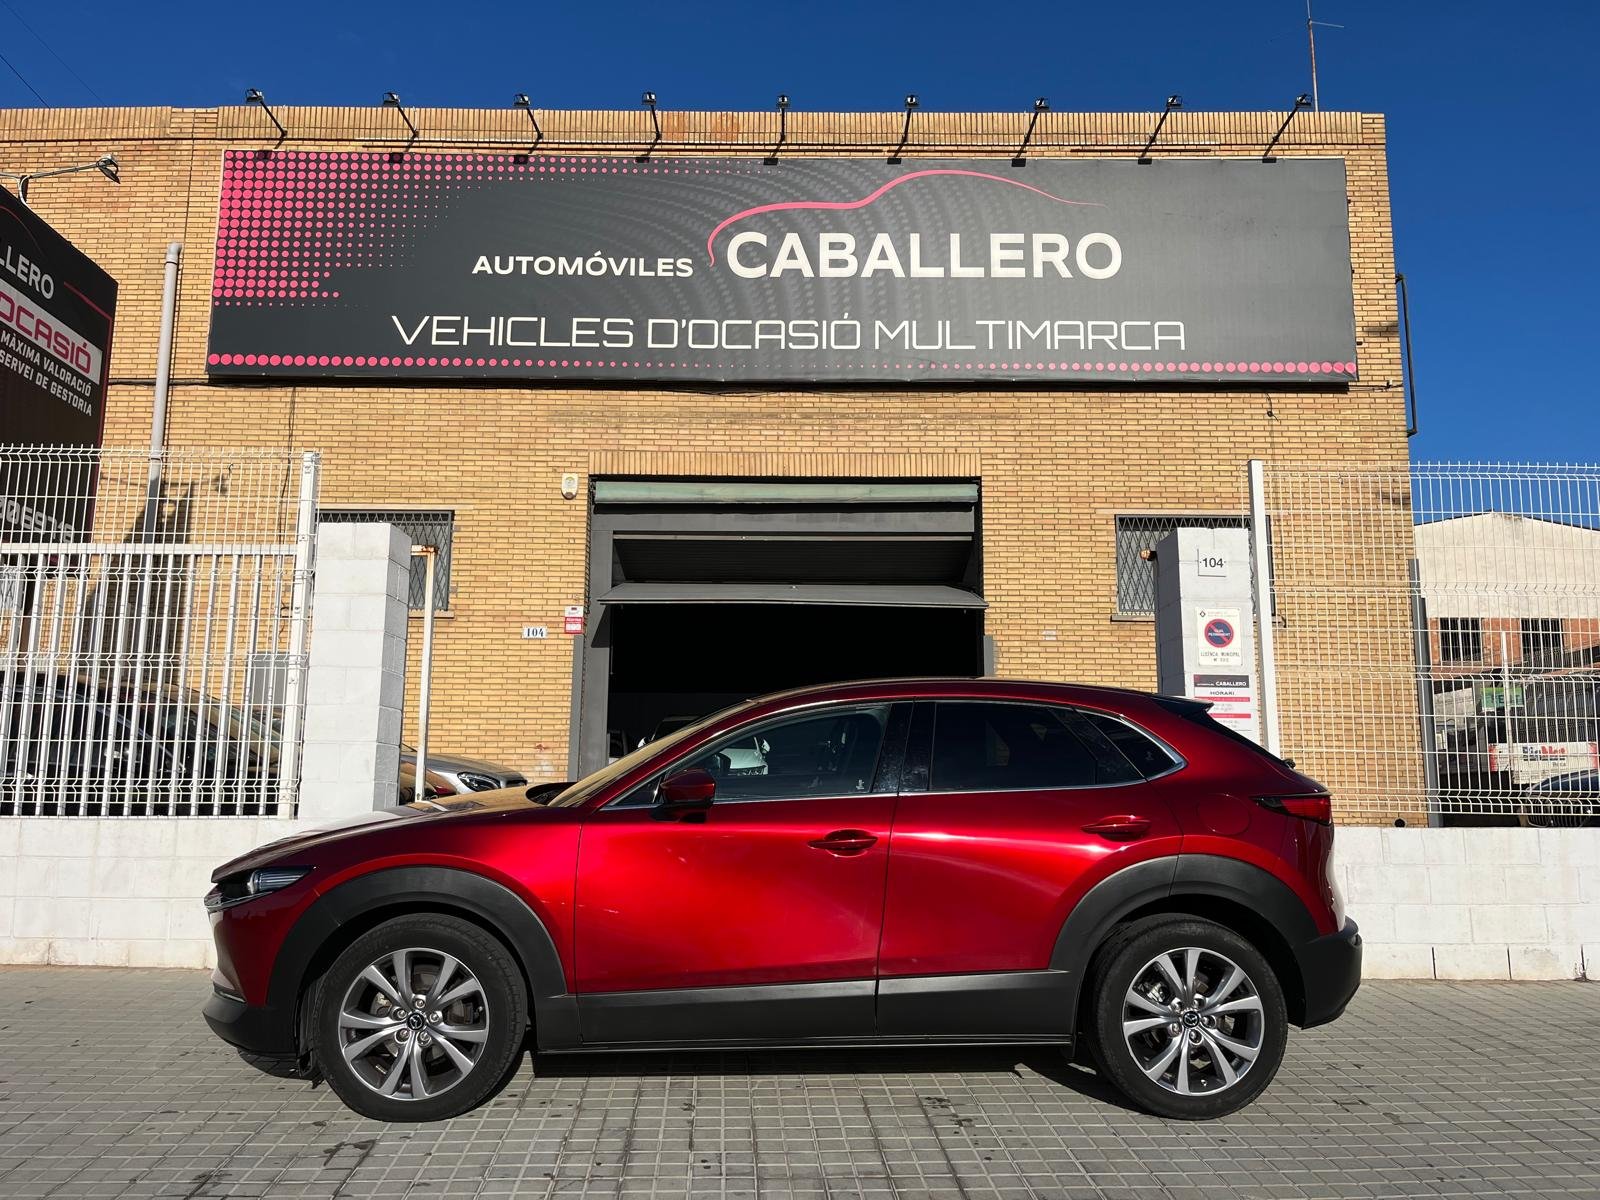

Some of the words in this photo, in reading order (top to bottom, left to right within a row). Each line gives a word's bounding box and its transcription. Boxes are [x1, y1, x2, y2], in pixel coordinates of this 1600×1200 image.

[472, 250, 694, 278] AUTOMÓVILES
[726, 231, 1123, 280] CABALLERO
[392, 315, 634, 348] VEHICLES
[647, 312, 862, 351] D'OCASIÓ
[874, 319, 1186, 352] MULTIMARCA
[0, 349, 33, 380] SERVEI
[36, 372, 48, 391] DE
[50, 382, 92, 417] GESTORIA
[1, 330, 40, 366] MÀXIMA
[44, 357, 92, 397] VALORACIÓ
[1202, 557, 1224, 568] 104
[527, 628, 544, 637] 104
